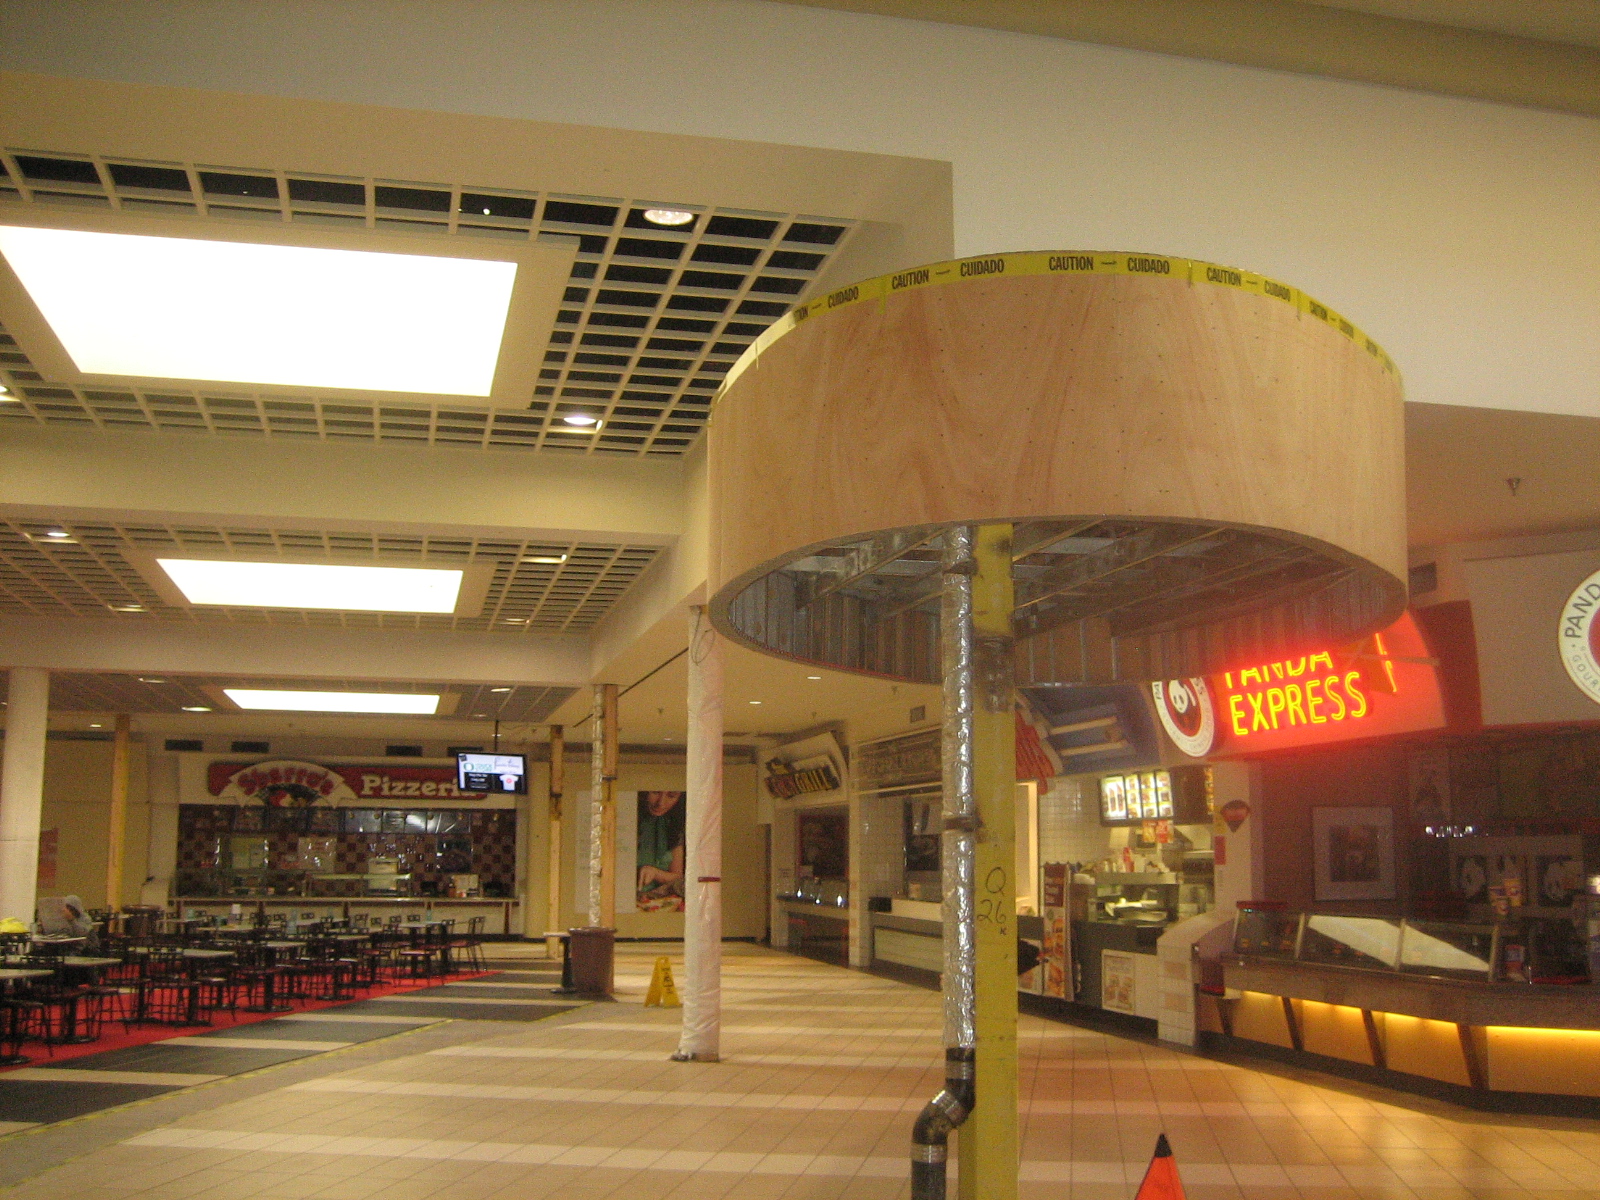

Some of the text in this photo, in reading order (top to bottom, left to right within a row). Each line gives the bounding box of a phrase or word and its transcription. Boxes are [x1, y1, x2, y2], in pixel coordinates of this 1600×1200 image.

[827, 286, 859, 309] CUIDADO
[891, 269, 930, 290] CAUTION
[960, 258, 1005, 277] CUIDADO
[1048, 256, 1094, 271] CAUTION
[1127, 257, 1170, 275] CUIDADO
[1206, 266, 1242, 287] CAUTION
[1229, 671, 1367, 736] EXPRESS
[360, 773, 477, 797] Pizzeri
[976, 899, 1007, 925] 26
